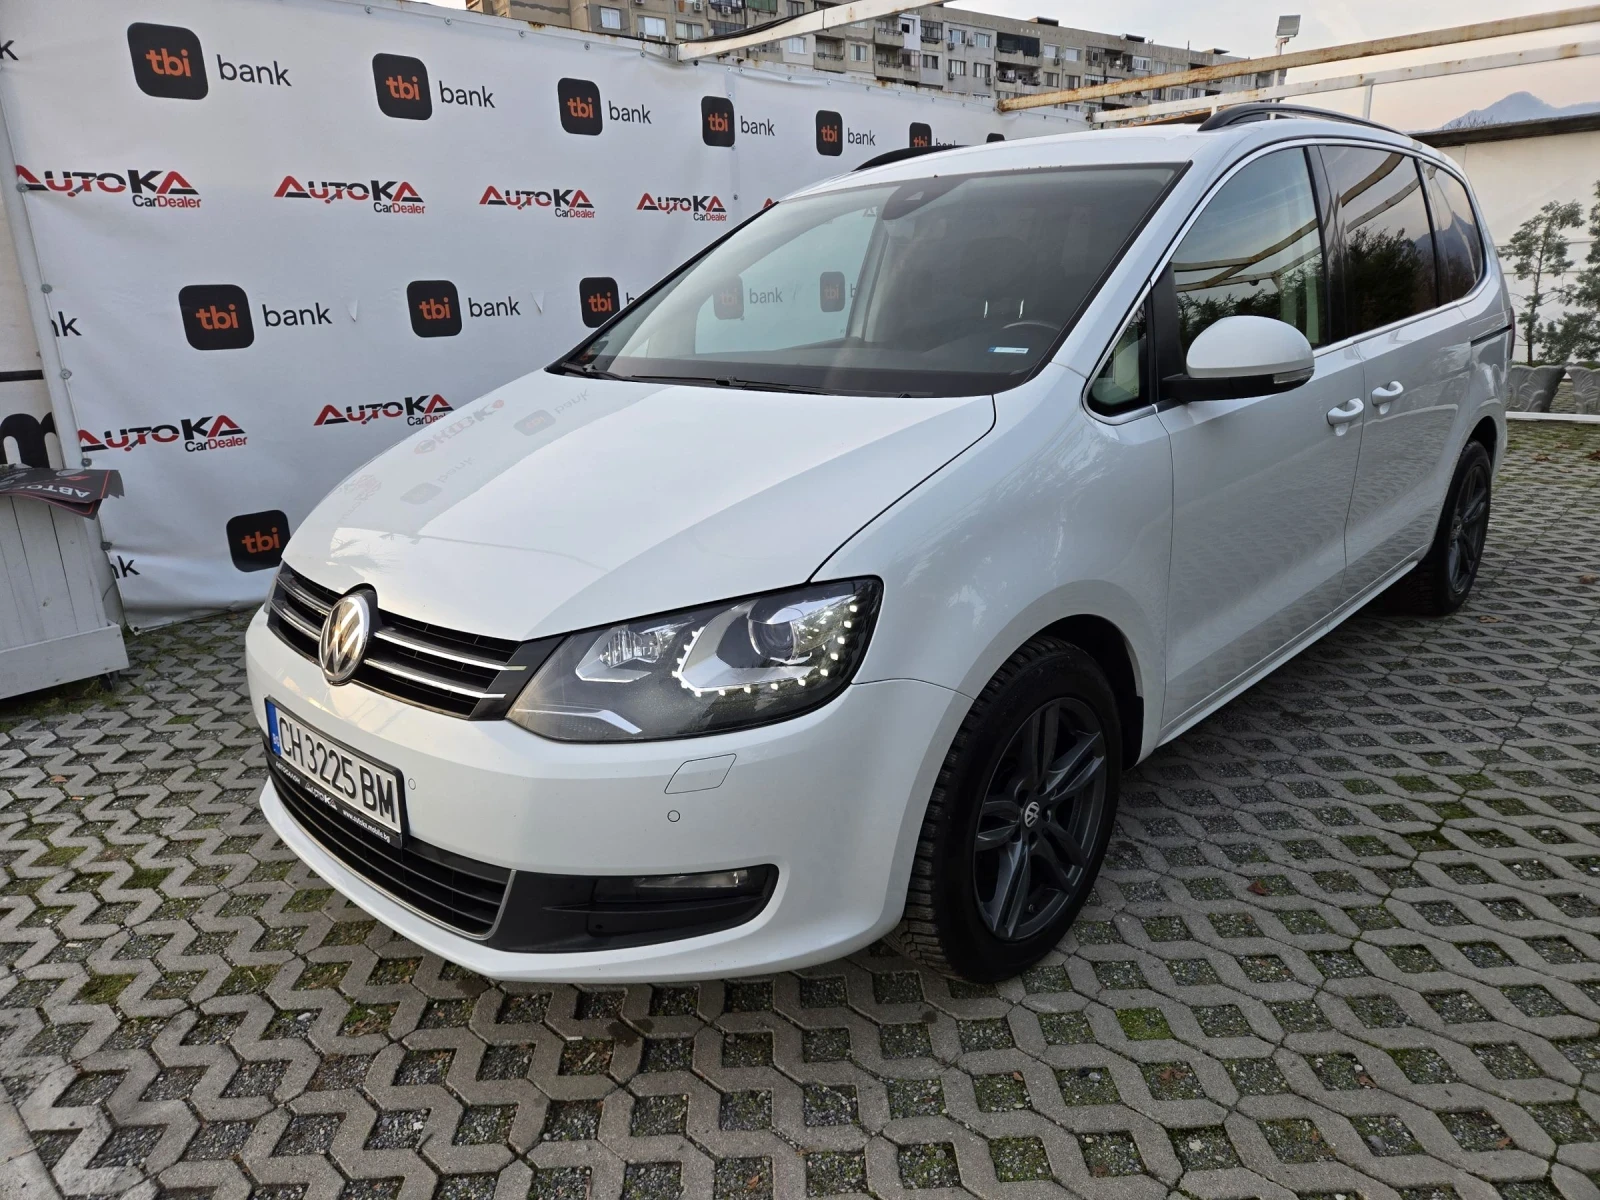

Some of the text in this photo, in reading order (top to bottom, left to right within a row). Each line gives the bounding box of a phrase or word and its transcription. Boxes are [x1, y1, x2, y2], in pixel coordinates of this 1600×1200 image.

[145, 48, 292, 87] tbi bank
[386, 75, 496, 109] tbi bank
[567, 96, 652, 125] tbi bank
[707, 113, 775, 137] tbi bank
[820, 125, 876, 146] tbi bank
[132, 194, 201, 209] CarDealer
[373, 201, 426, 214] CarDealer
[554, 207, 596, 219] CarDealer
[588, 292, 613, 313] tbi
[749, 287, 784, 304] bank
[195, 302, 333, 331] tbi bank
[419, 295, 521, 320] tbi bank
[184, 435, 248, 453] CarDealer
[241, 526, 281, 554] tbi
